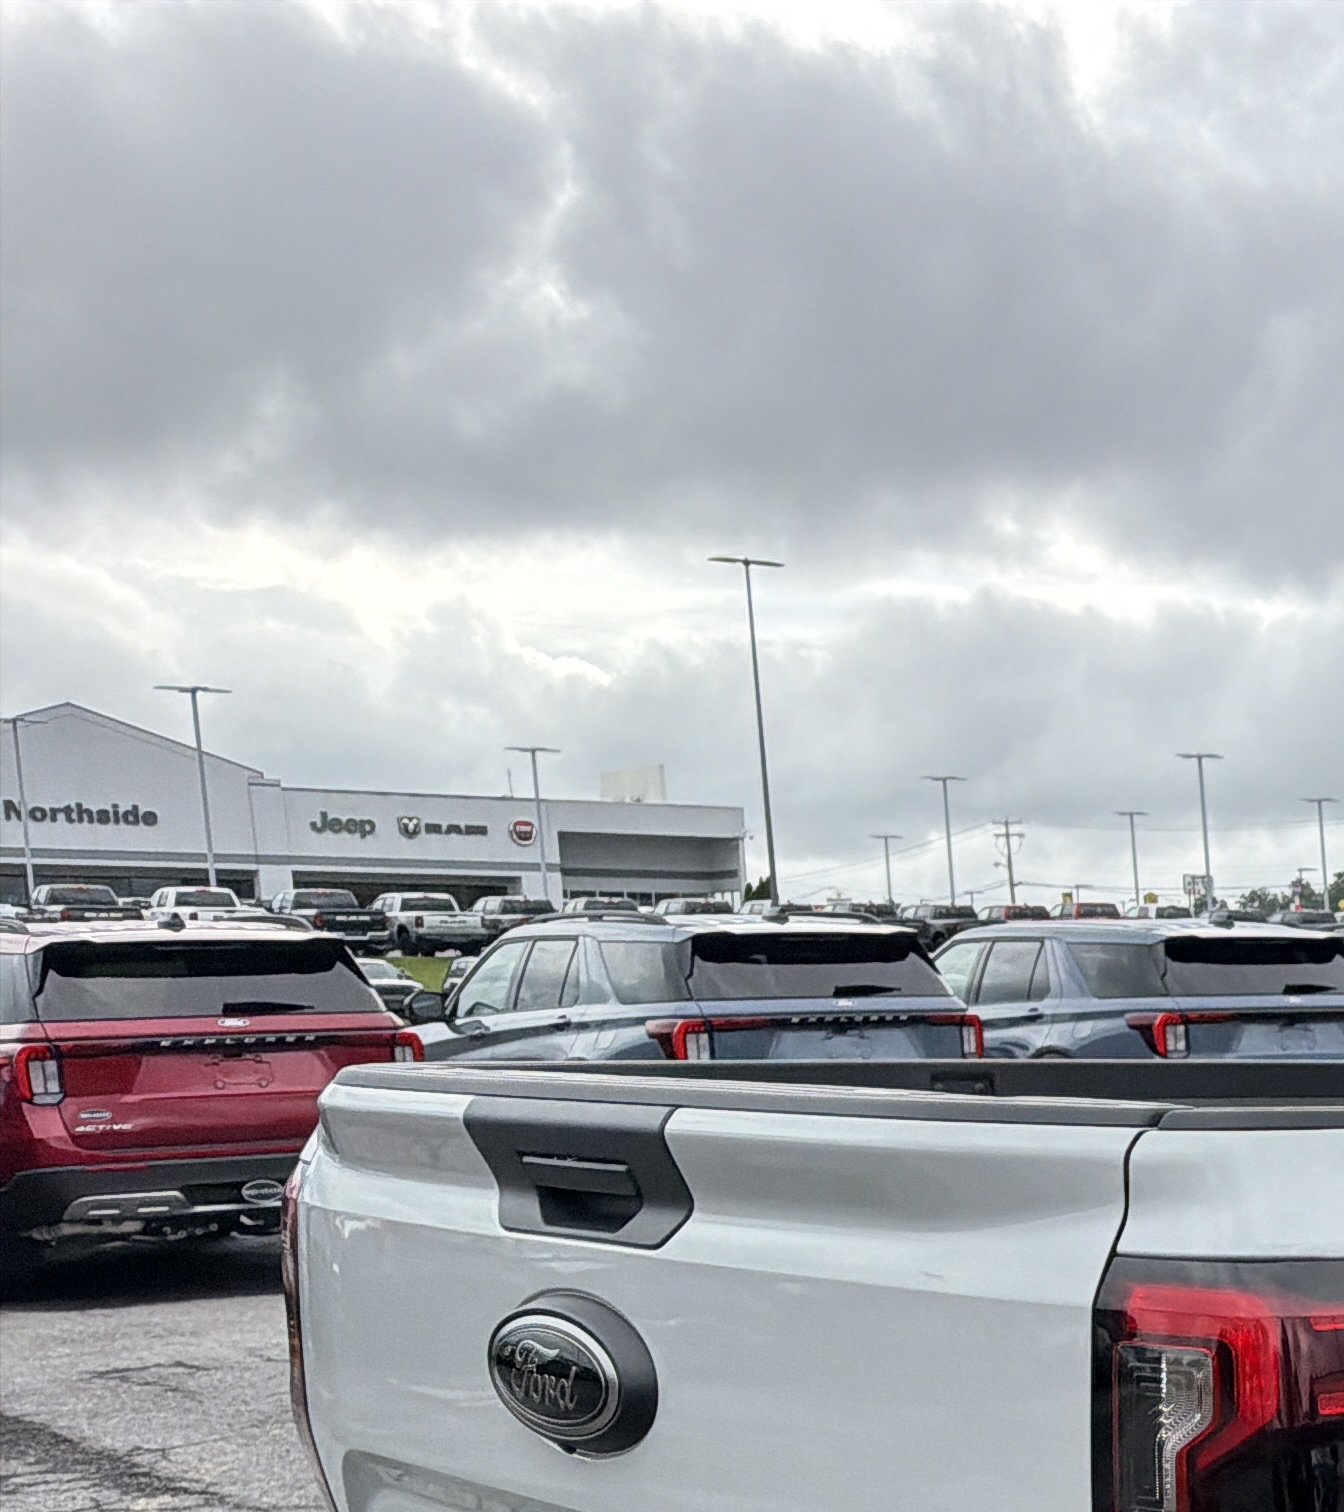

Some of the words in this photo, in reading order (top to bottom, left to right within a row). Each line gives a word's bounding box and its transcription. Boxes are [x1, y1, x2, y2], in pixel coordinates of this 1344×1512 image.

[3, 799, 158, 826] Northside
[310, 811, 377, 839] Jeep
[425, 823, 488, 836] RAM
[75, 1123, 133, 1132] ACTIVE
[511, 1339, 580, 1411] Ford
